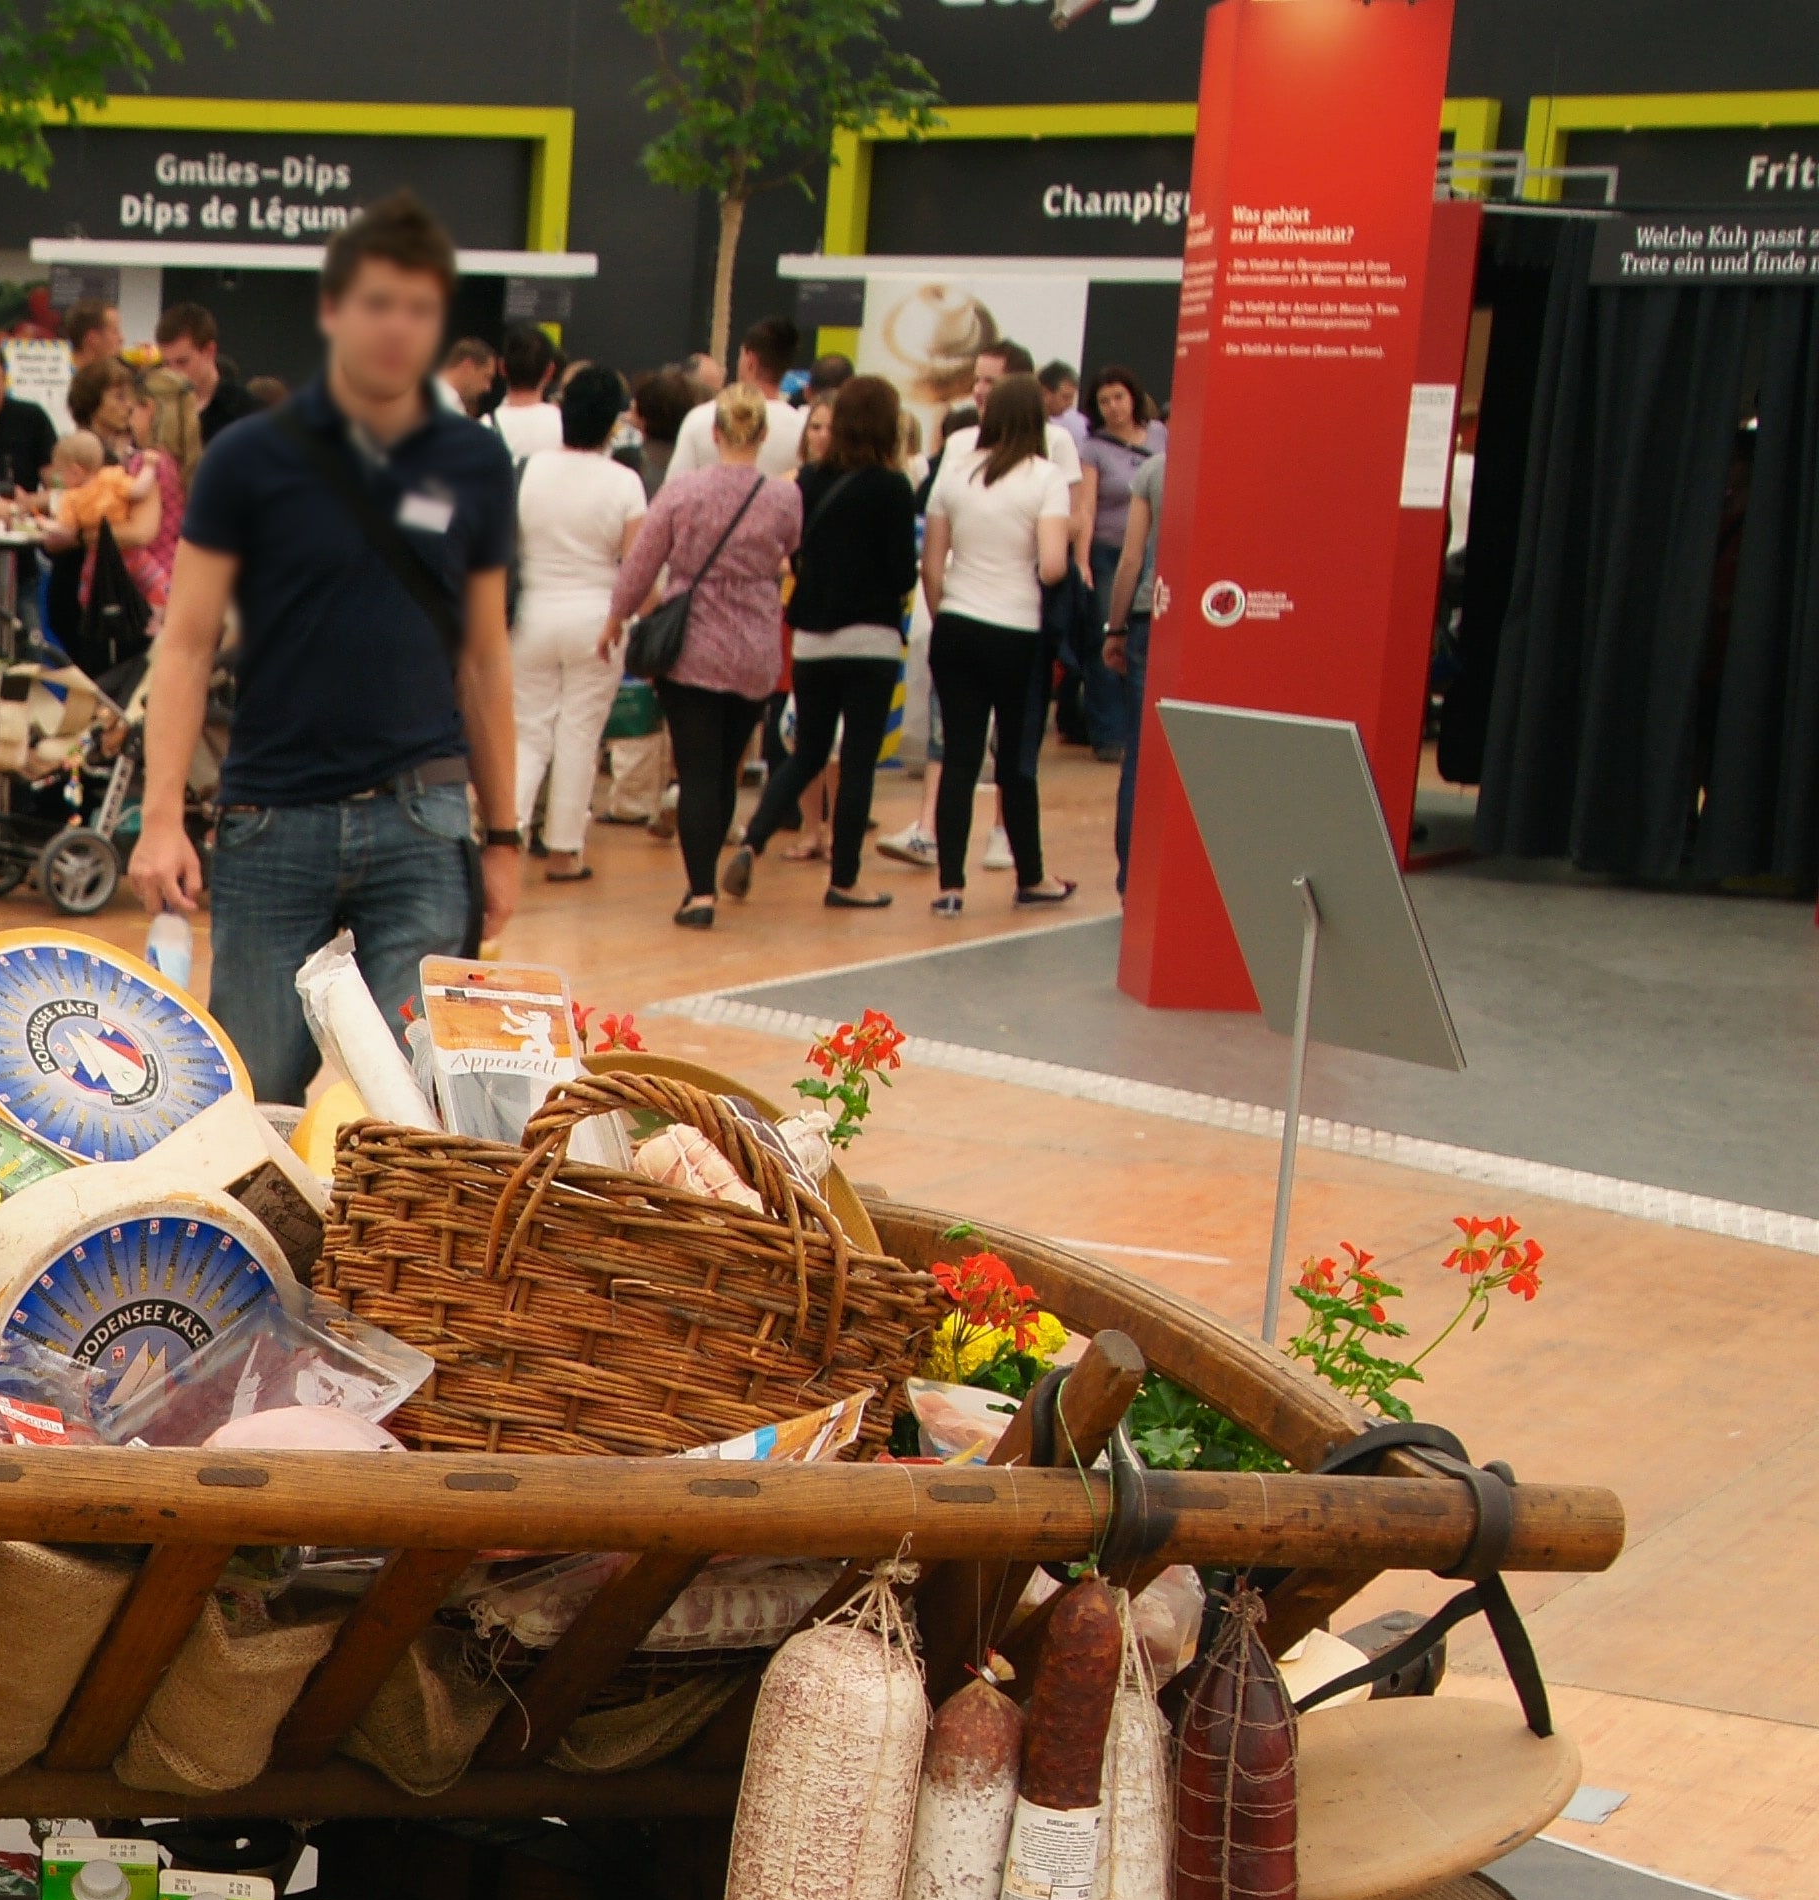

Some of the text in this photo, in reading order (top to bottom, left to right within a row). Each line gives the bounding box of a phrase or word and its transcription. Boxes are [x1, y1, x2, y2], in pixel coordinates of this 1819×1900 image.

[1746, 152, 1819, 191] Frit
[120, 192, 189, 234] Dips
[200, 196, 237, 229] de
[1043, 182, 1191, 225] Champig
[1232, 204, 1310, 228] Was gehört
[1230, 225, 1355, 245] zur Biodiversität?
[1637, 223, 1804, 253] Welche Kuh passt
[1620, 250, 1806, 276] Trete ein und finde
[28, 1001, 96, 1073] BODENSEE KÄSE
[450, 1053, 558, 1076] Appenzell
[76, 1304, 209, 1365] BODENSEE KÄSE
